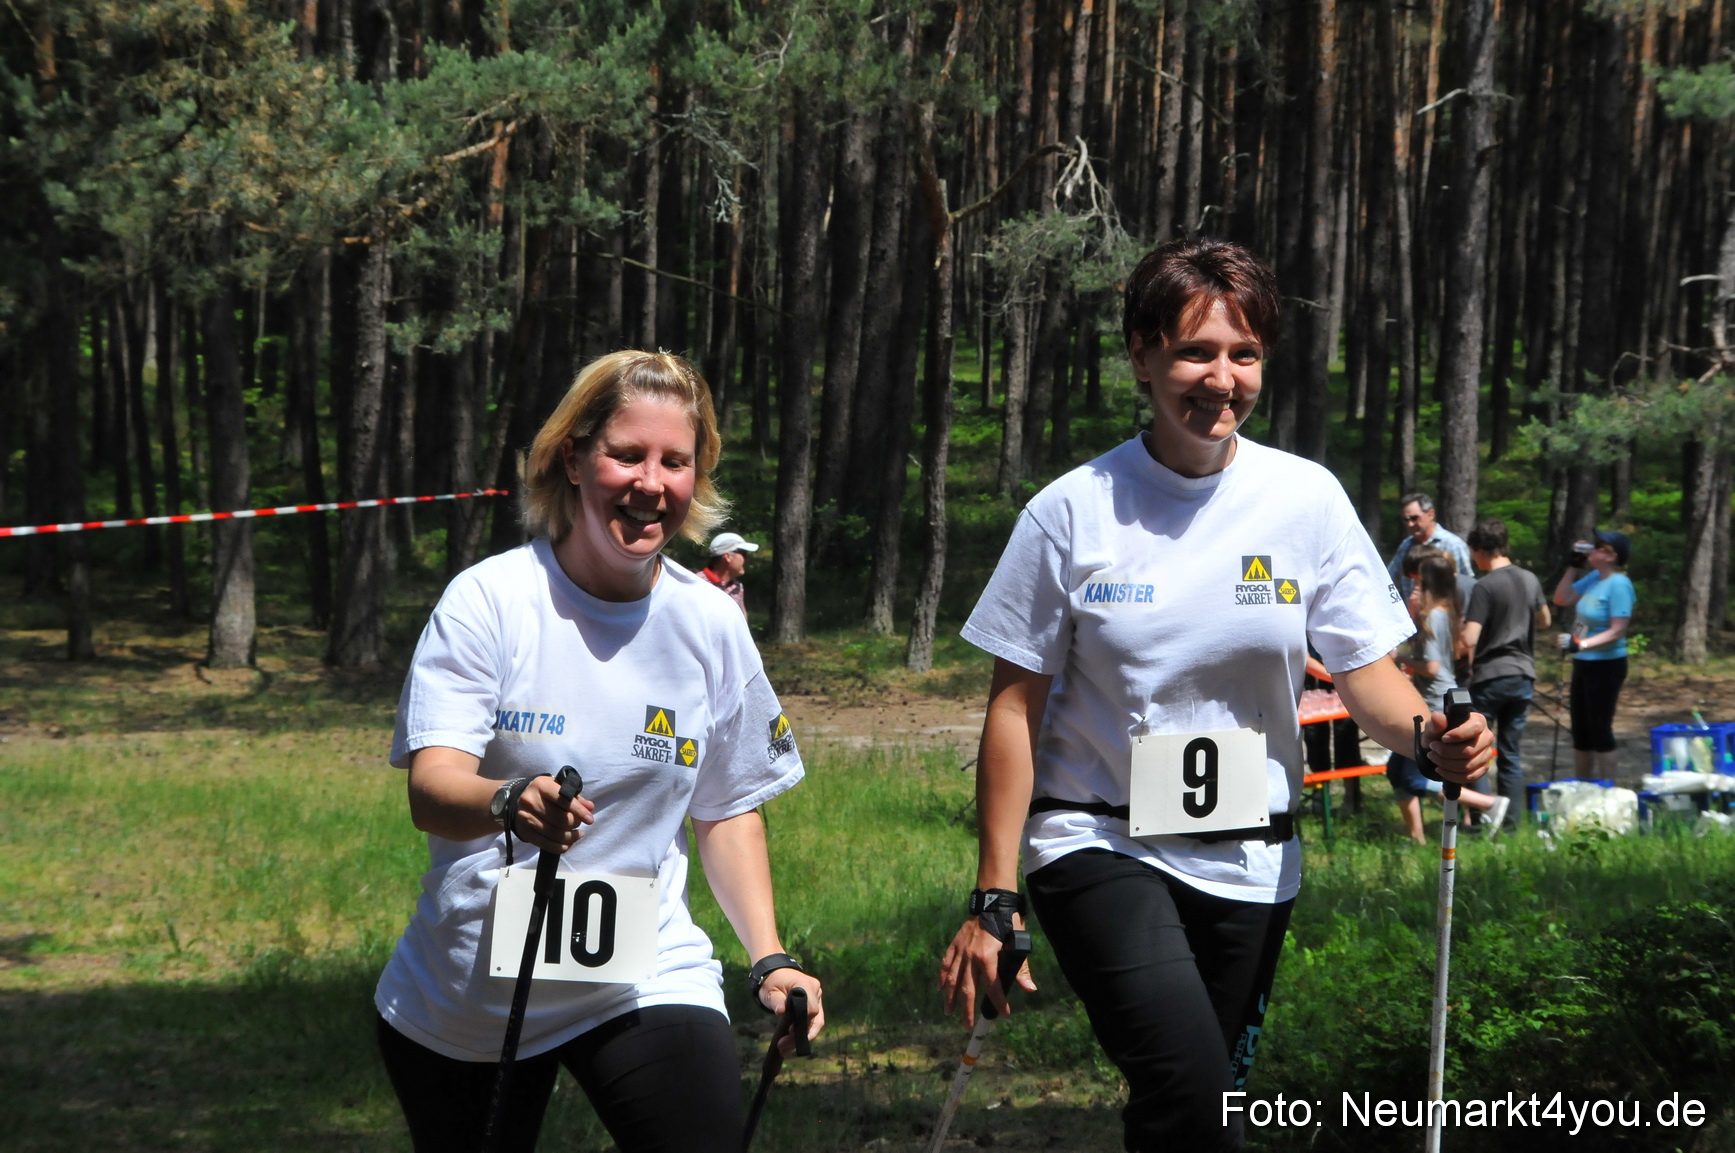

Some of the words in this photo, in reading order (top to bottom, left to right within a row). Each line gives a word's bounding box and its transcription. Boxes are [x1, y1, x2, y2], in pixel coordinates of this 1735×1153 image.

[1083, 582, 1155, 603] KANISTER
[1235, 584, 1271, 593] RYGOL
[1235, 592, 1272, 605] SAKRET
[538, 713, 566, 736] 748
[634, 734, 672, 750] RYGOL
[631, 744, 672, 763] SAKRET
[1182, 736, 1219, 819] 9
[542, 877, 617, 968] 10
